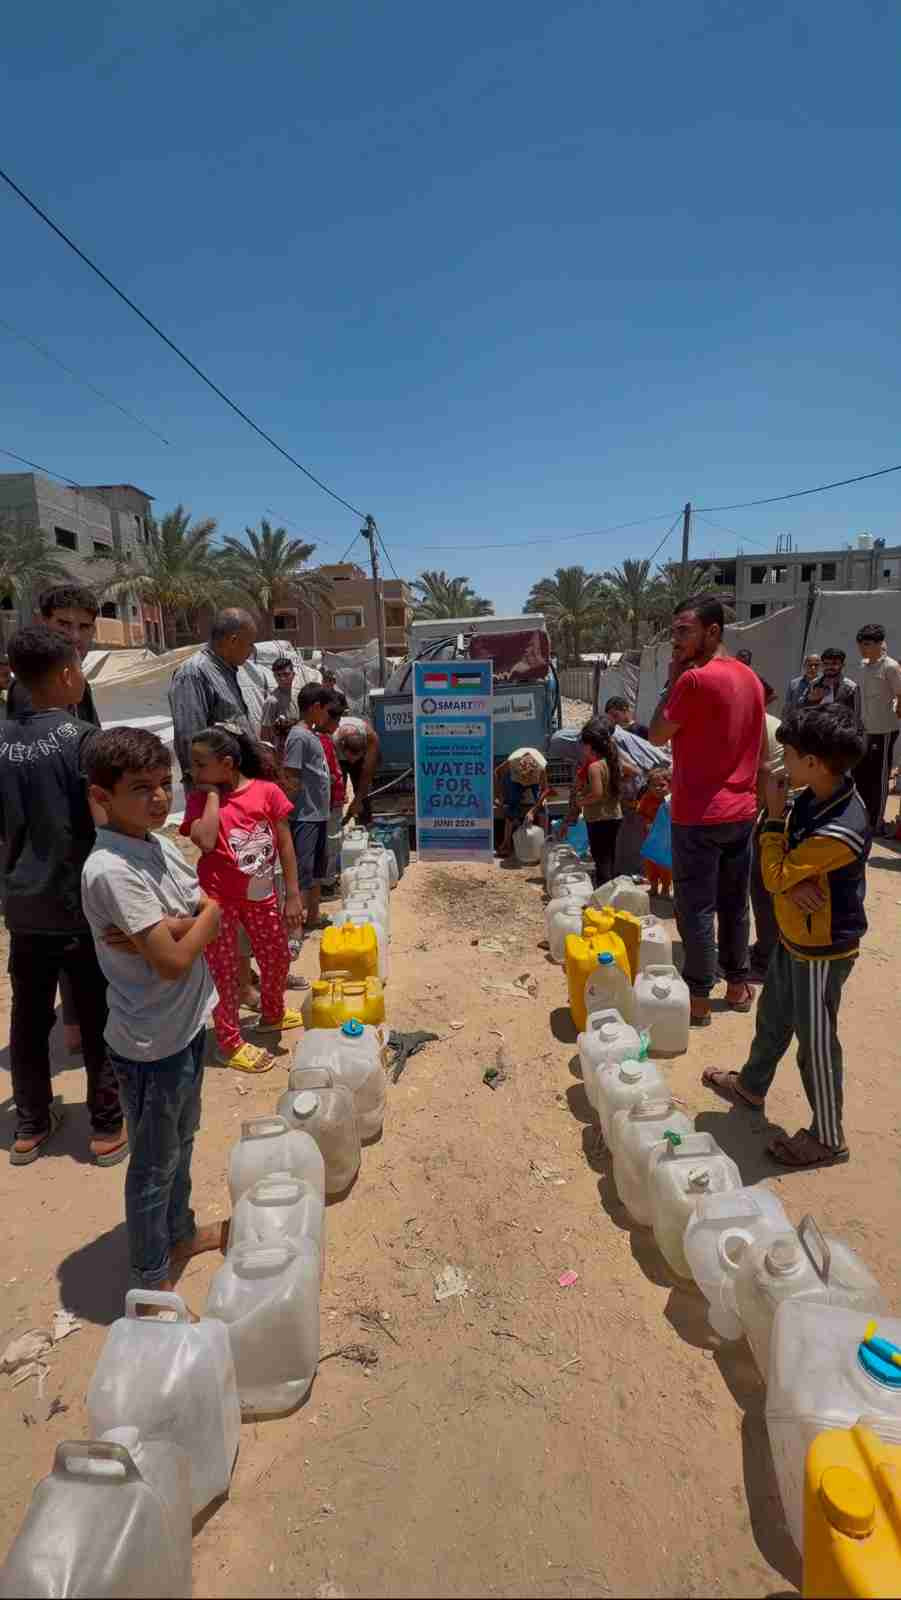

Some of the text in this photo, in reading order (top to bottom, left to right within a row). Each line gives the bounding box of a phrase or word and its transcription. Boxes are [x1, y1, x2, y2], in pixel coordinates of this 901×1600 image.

[422, 761, 487, 776] WATER
[435, 778, 473, 792] FOR
[430, 794, 480, 808] GAZA
[433, 819, 454, 828] JUNI
